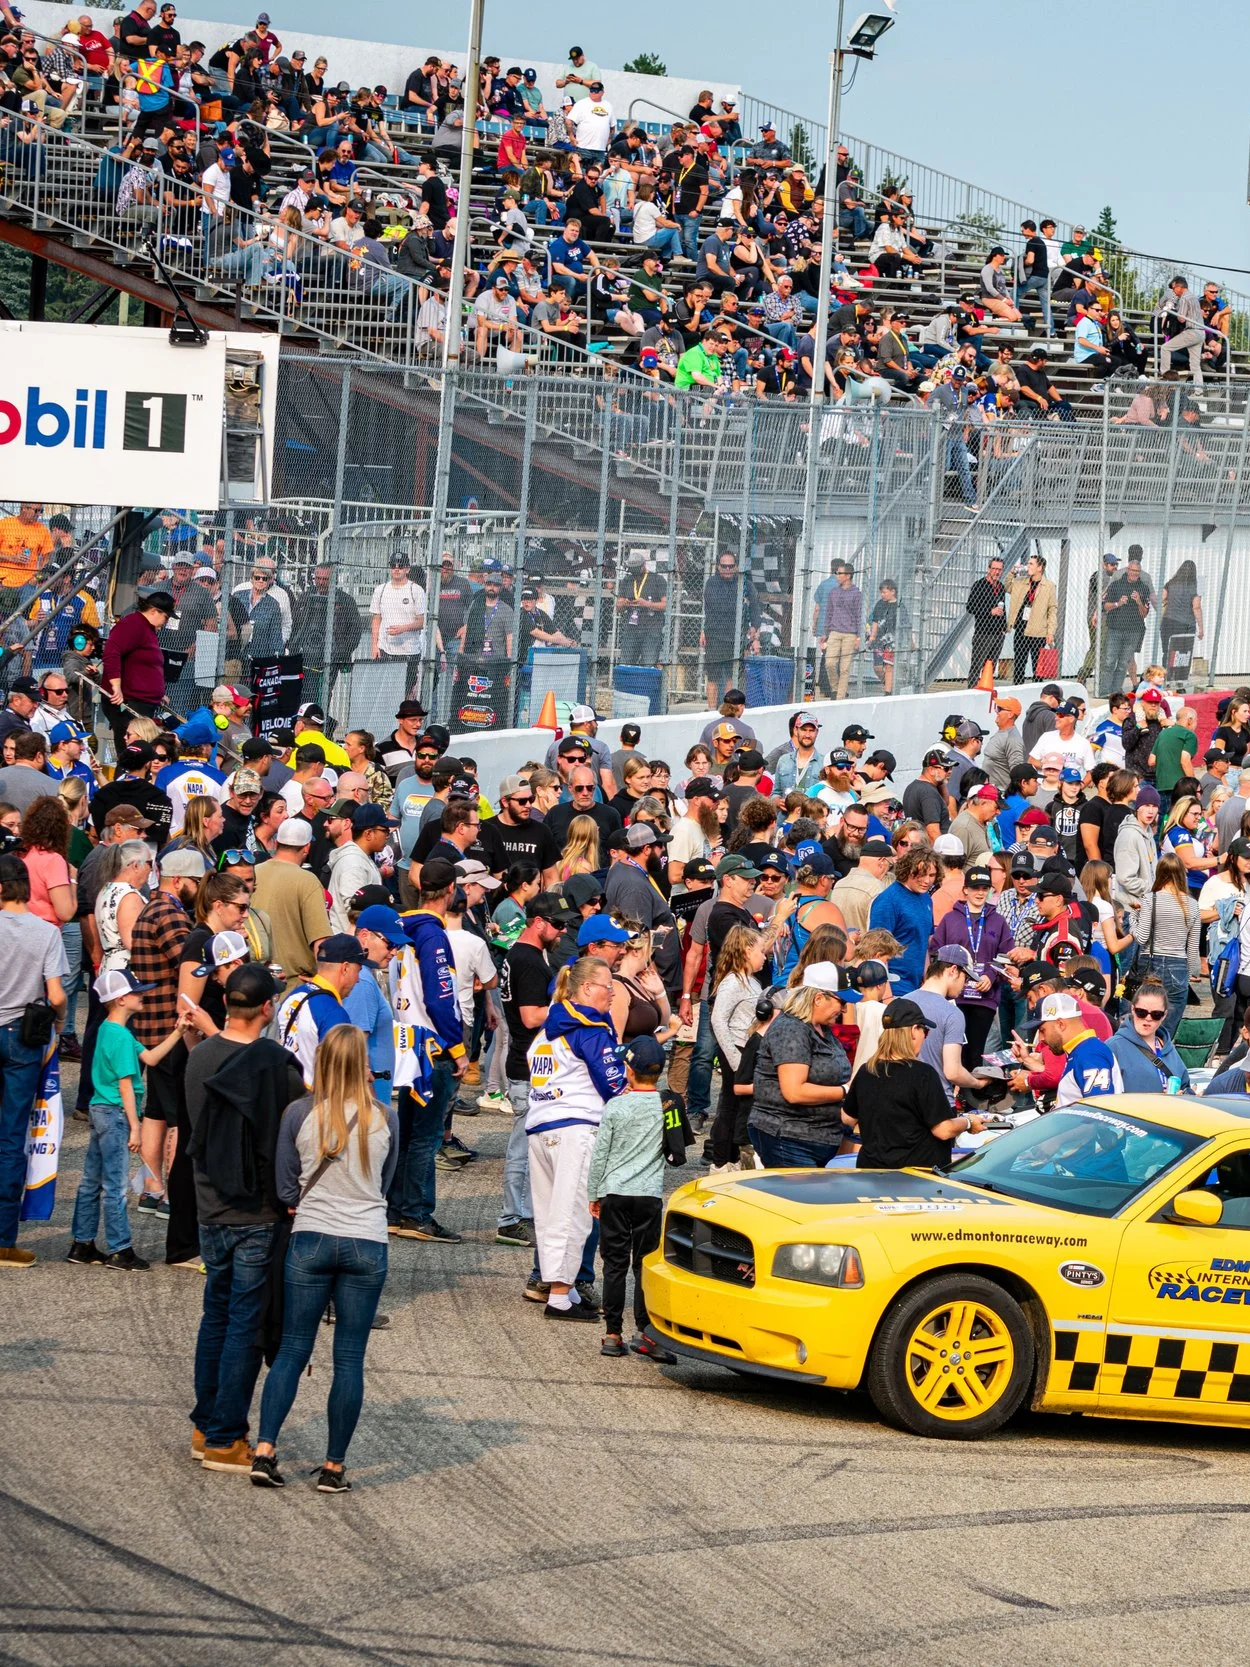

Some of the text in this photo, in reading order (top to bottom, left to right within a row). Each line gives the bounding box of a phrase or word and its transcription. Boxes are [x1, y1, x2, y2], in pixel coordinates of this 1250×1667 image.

[142, 397, 163, 448] 1
[259, 678, 282, 688] CANADA
[261, 717, 292, 731] WELCOME
[187, 783, 204, 795] NAPA
[1177, 833, 1190, 844] 74
[531, 1057, 554, 1076] NAPA
[1083, 1068, 1111, 1094] 74
[910, 1229, 1088, 1248] www.edmontonraceway.com
[1066, 1270, 1099, 1280] PINTY'S
